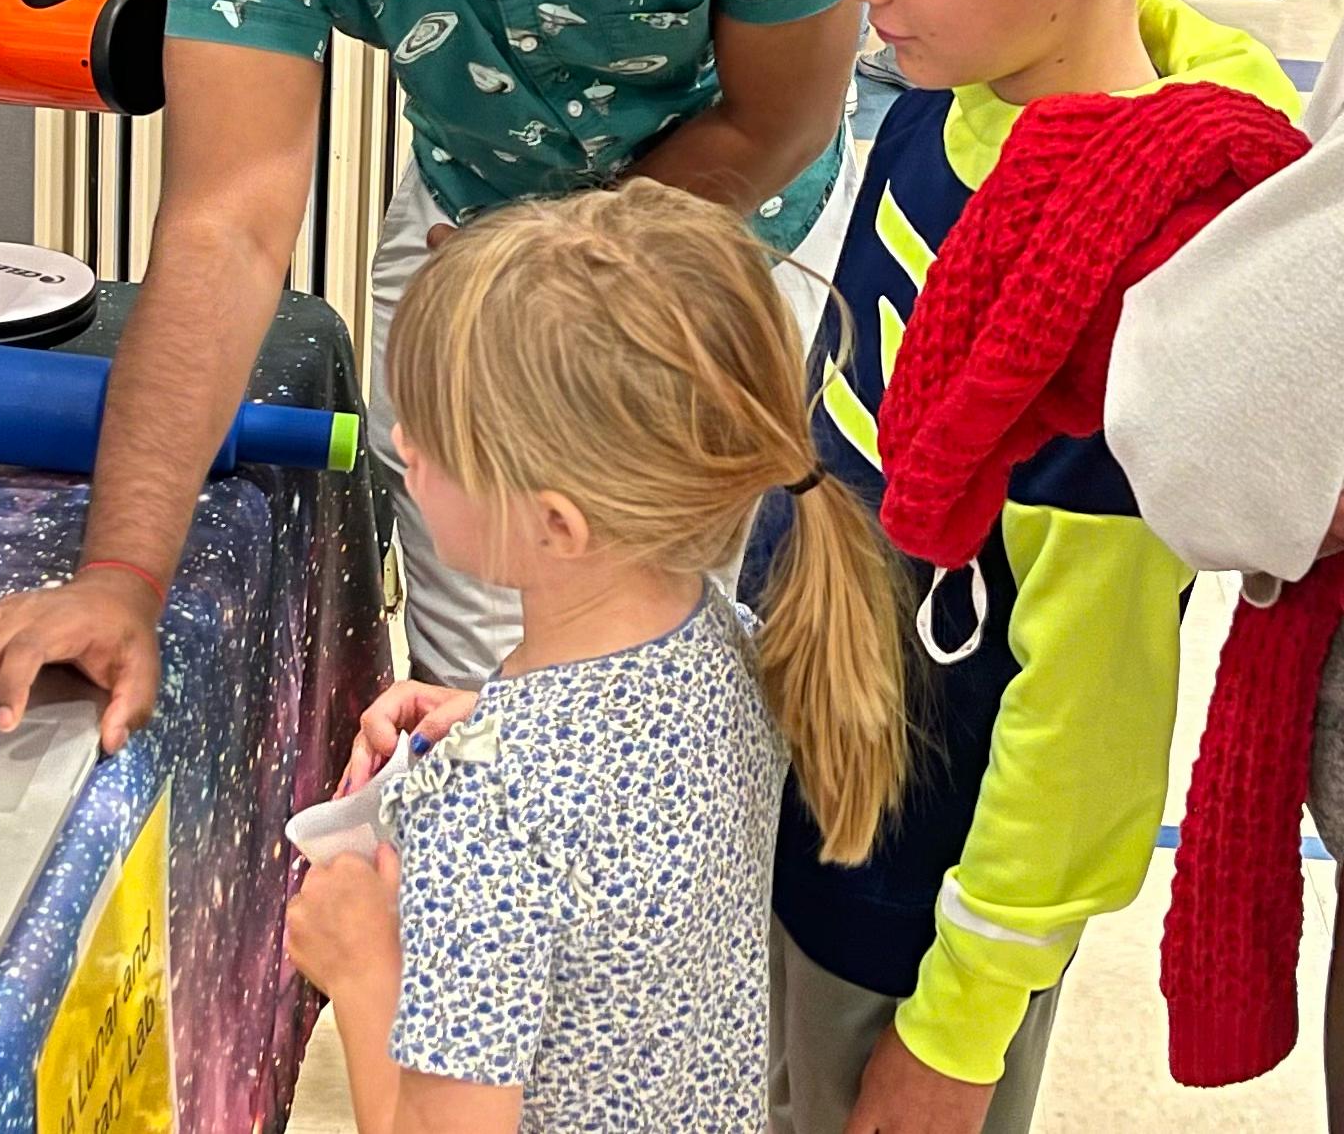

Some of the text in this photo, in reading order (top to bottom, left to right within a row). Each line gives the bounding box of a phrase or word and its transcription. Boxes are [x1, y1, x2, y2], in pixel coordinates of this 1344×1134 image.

[77, 986, 121, 1115] Lunar
[123, 909, 152, 1003] and
[128, 995, 155, 1077] Lab
